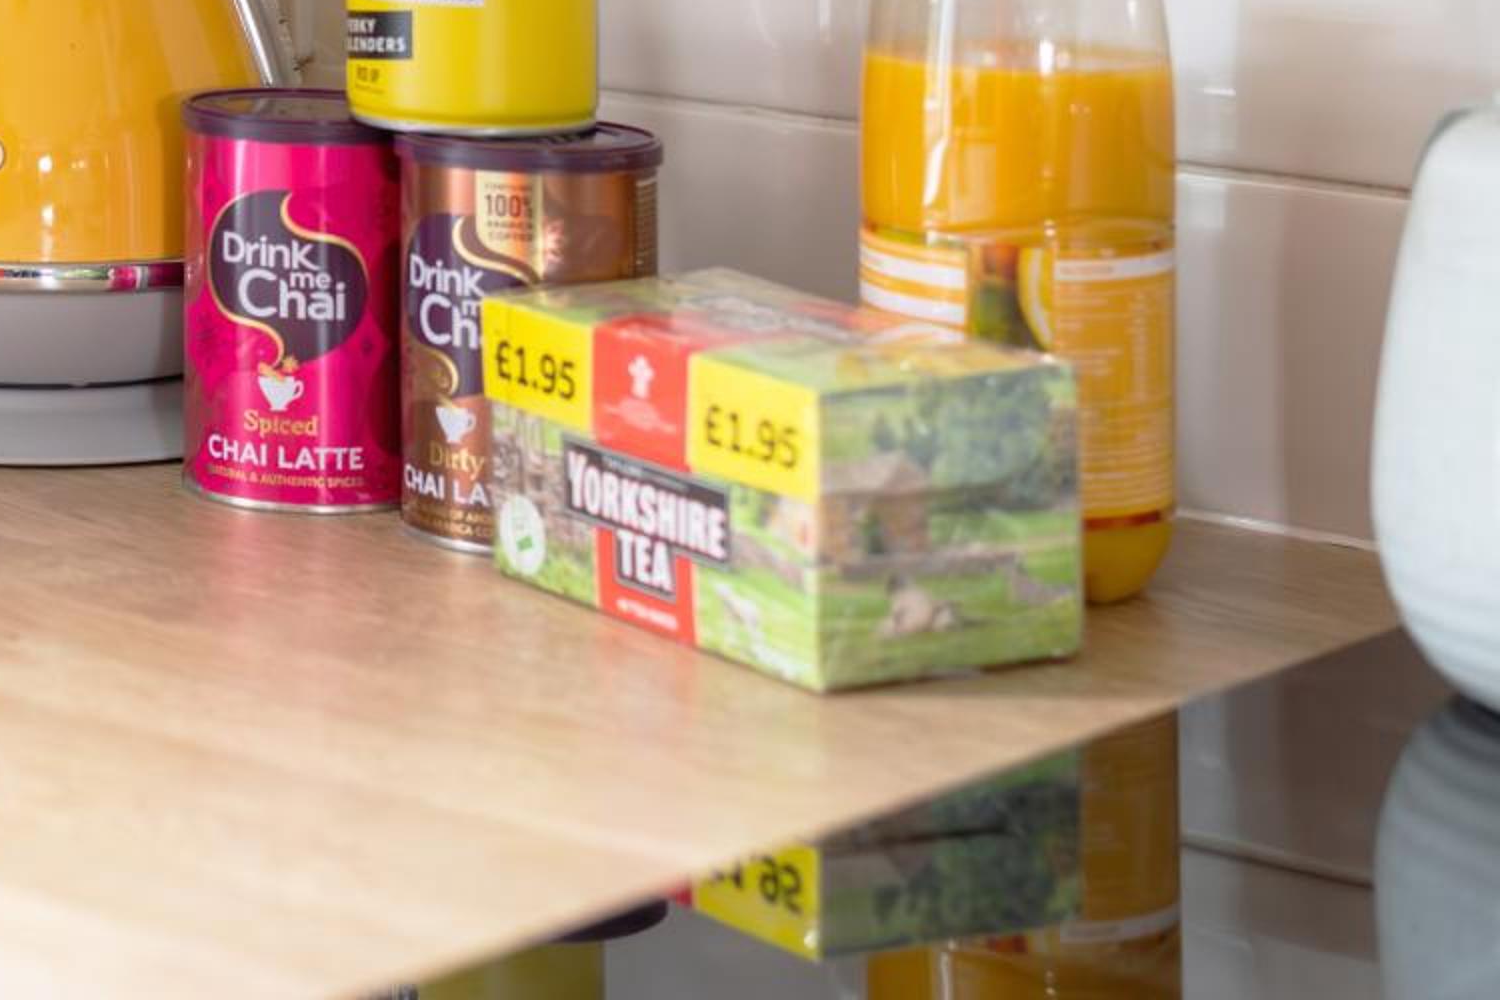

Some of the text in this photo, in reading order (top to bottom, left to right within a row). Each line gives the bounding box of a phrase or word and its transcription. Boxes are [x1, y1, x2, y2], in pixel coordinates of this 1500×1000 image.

[348, 36, 406, 53] LENDERS
[222, 231, 320, 271] Drink
[238, 268, 346, 320] Chai
[289, 271, 331, 290] me
[409, 254, 485, 298] Drink
[420, 293, 479, 350] Ch
[496, 339, 576, 401] £1.95
[243, 409, 319, 439] Spiced
[705, 404, 799, 469] £1.95
[208, 433, 365, 471] CHAI LATTE
[404, 462, 446, 500] CHAI
[568, 450, 729, 560] YORKSHIRE
[616, 529, 677, 593] TEA
